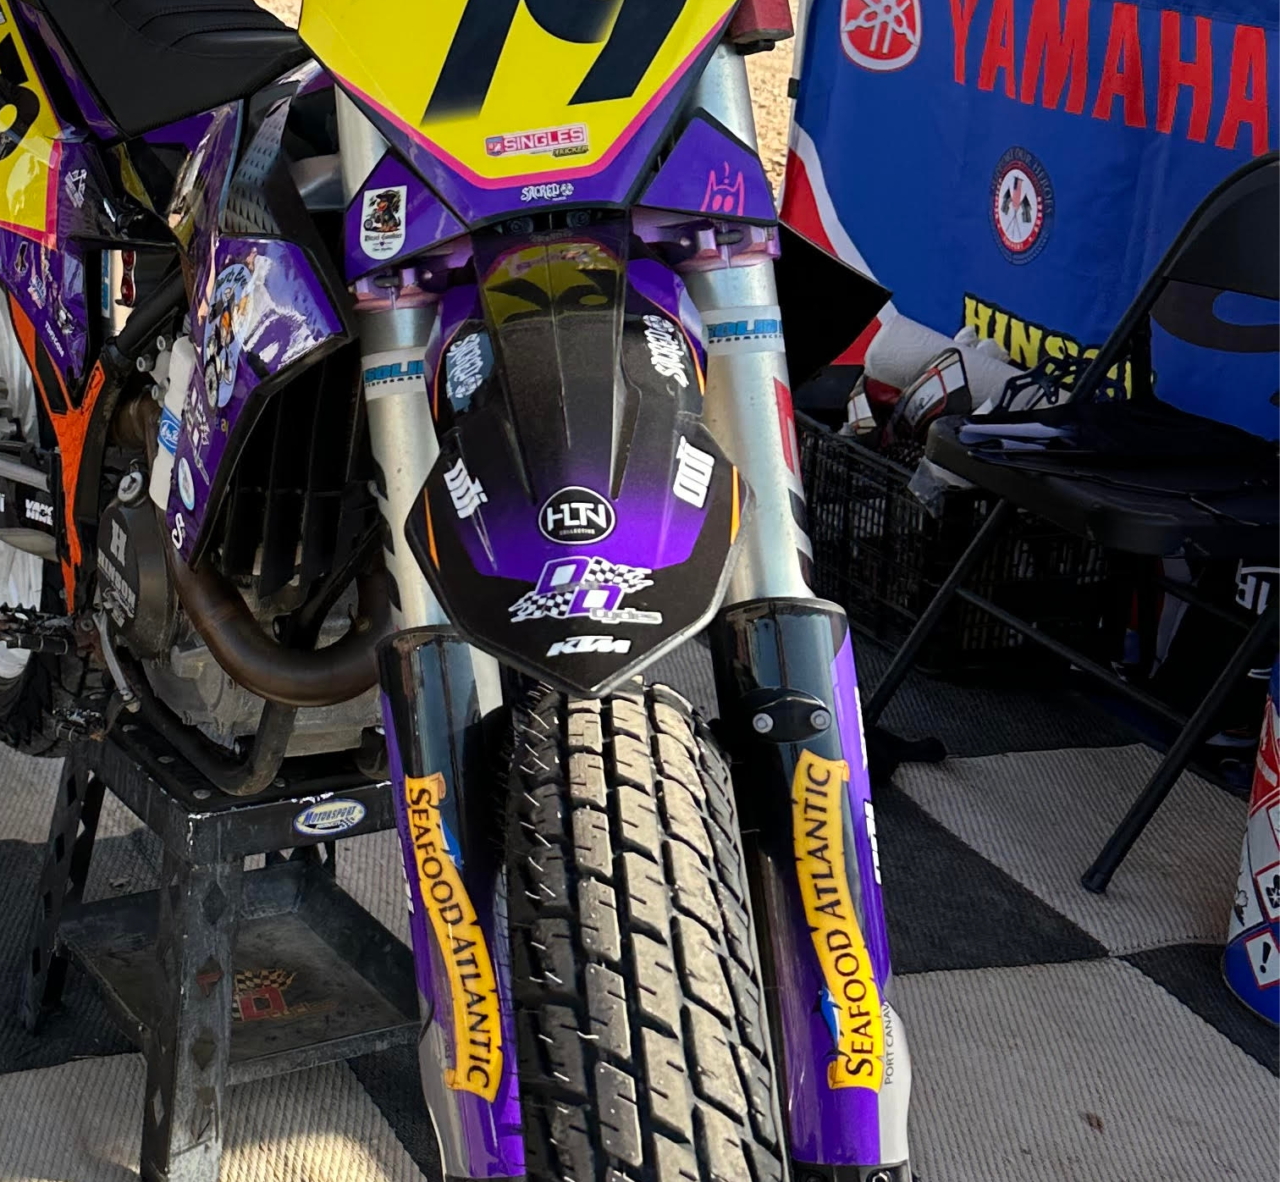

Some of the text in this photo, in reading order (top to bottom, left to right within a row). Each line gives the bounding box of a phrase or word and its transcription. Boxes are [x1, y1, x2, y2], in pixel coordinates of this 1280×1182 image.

[503, 127, 584, 151] SINGLES
[520, 183, 560, 202] SACRED
[547, 635, 631, 658] KTM
[303, 805, 358, 826] MOTORSPORT
[797, 763, 841, 919] ATLANTIC
[409, 787, 491, 1089] SEAFOOD ATLANTIC
[826, 928, 874, 1078] SEAFOOD
[884, 1053, 895, 1086] PORT
